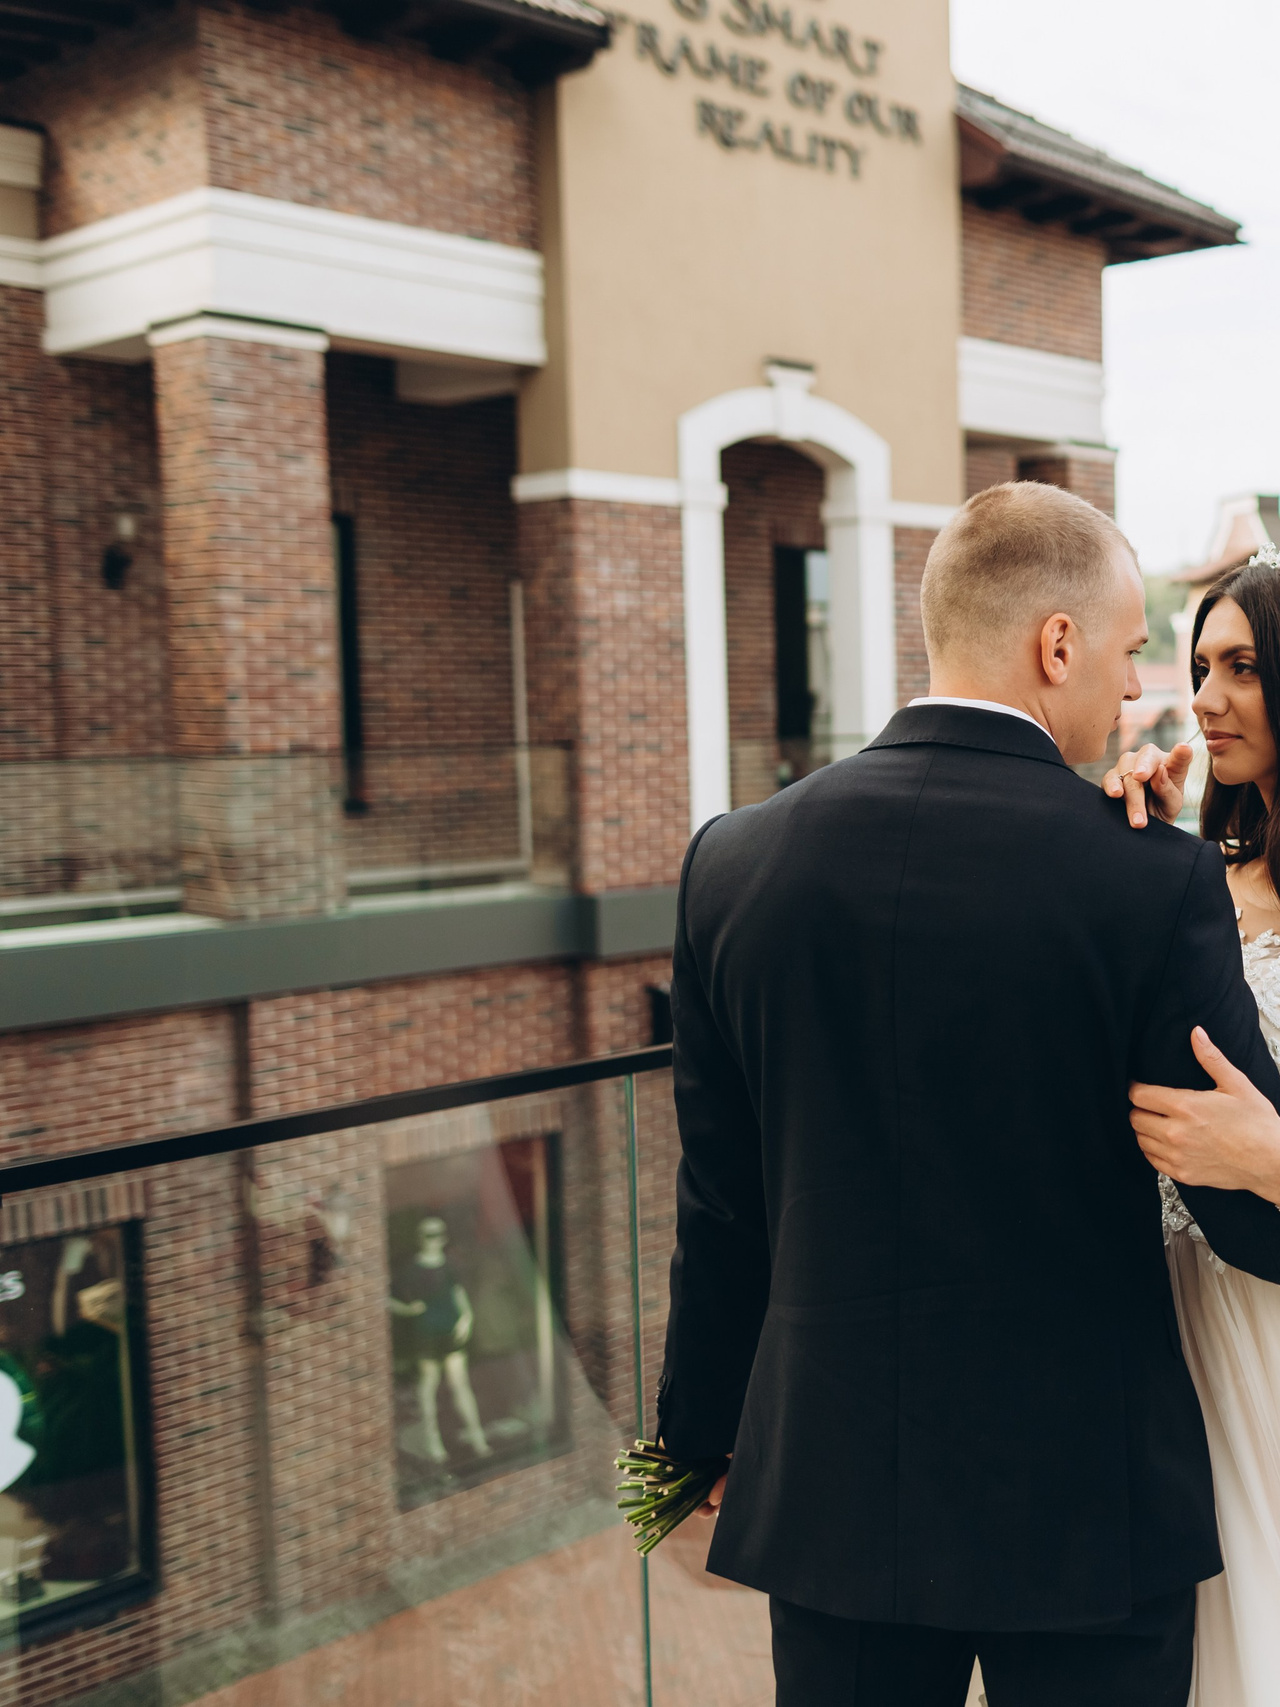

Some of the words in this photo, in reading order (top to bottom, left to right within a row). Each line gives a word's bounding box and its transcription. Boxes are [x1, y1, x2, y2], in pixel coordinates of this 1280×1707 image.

[695, 97, 867, 179] REALITY
[786, 73, 836, 115] OF
[845, 91, 922, 147] OUR
